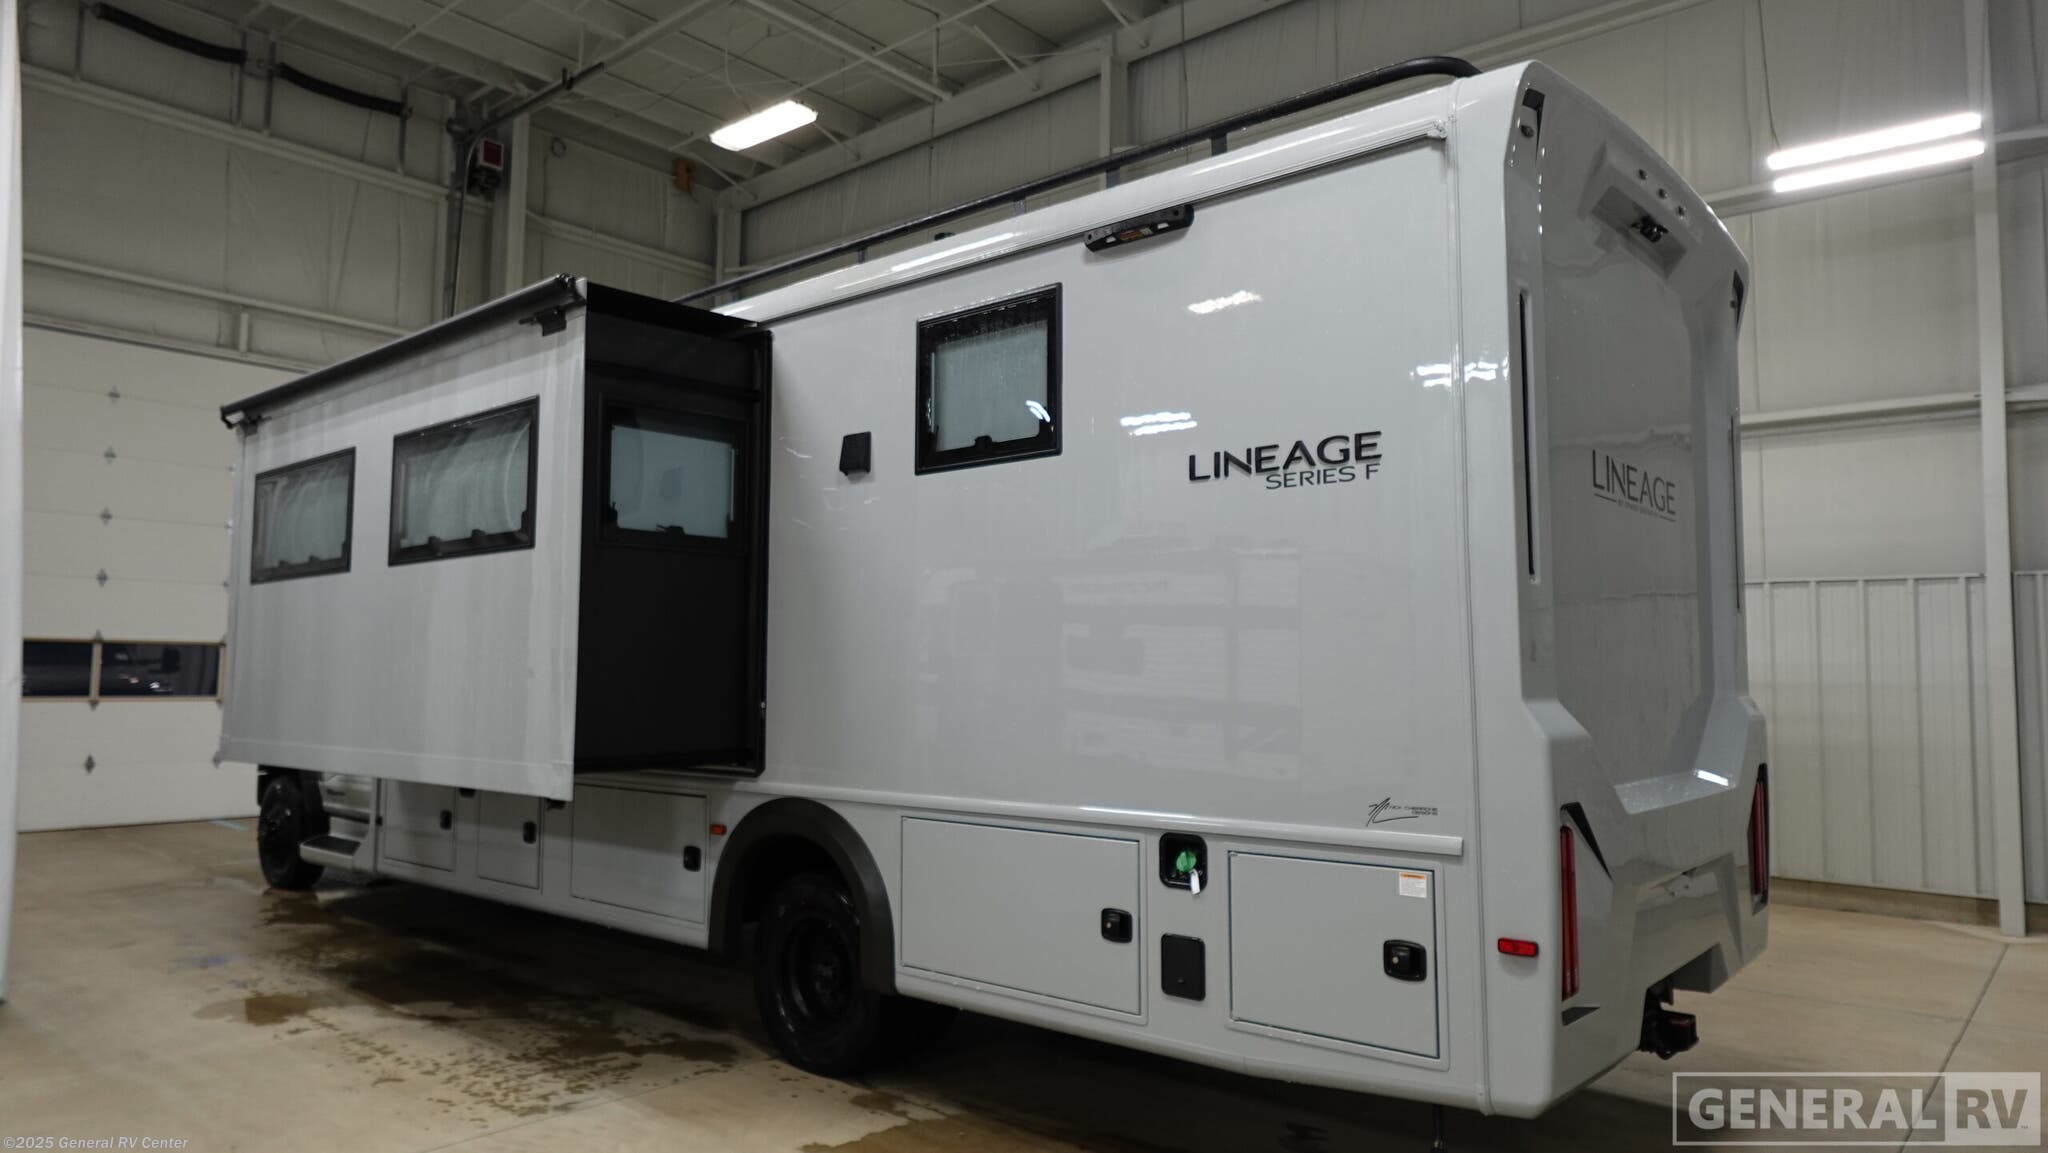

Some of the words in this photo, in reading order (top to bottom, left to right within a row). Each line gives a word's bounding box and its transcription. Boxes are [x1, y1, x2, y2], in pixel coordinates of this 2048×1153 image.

[1189, 431, 1382, 481] LINEAGE
[1266, 466, 1356, 490] SERIES
[1365, 463, 1381, 480] F
[1592, 449, 1676, 515] LINEAGE
